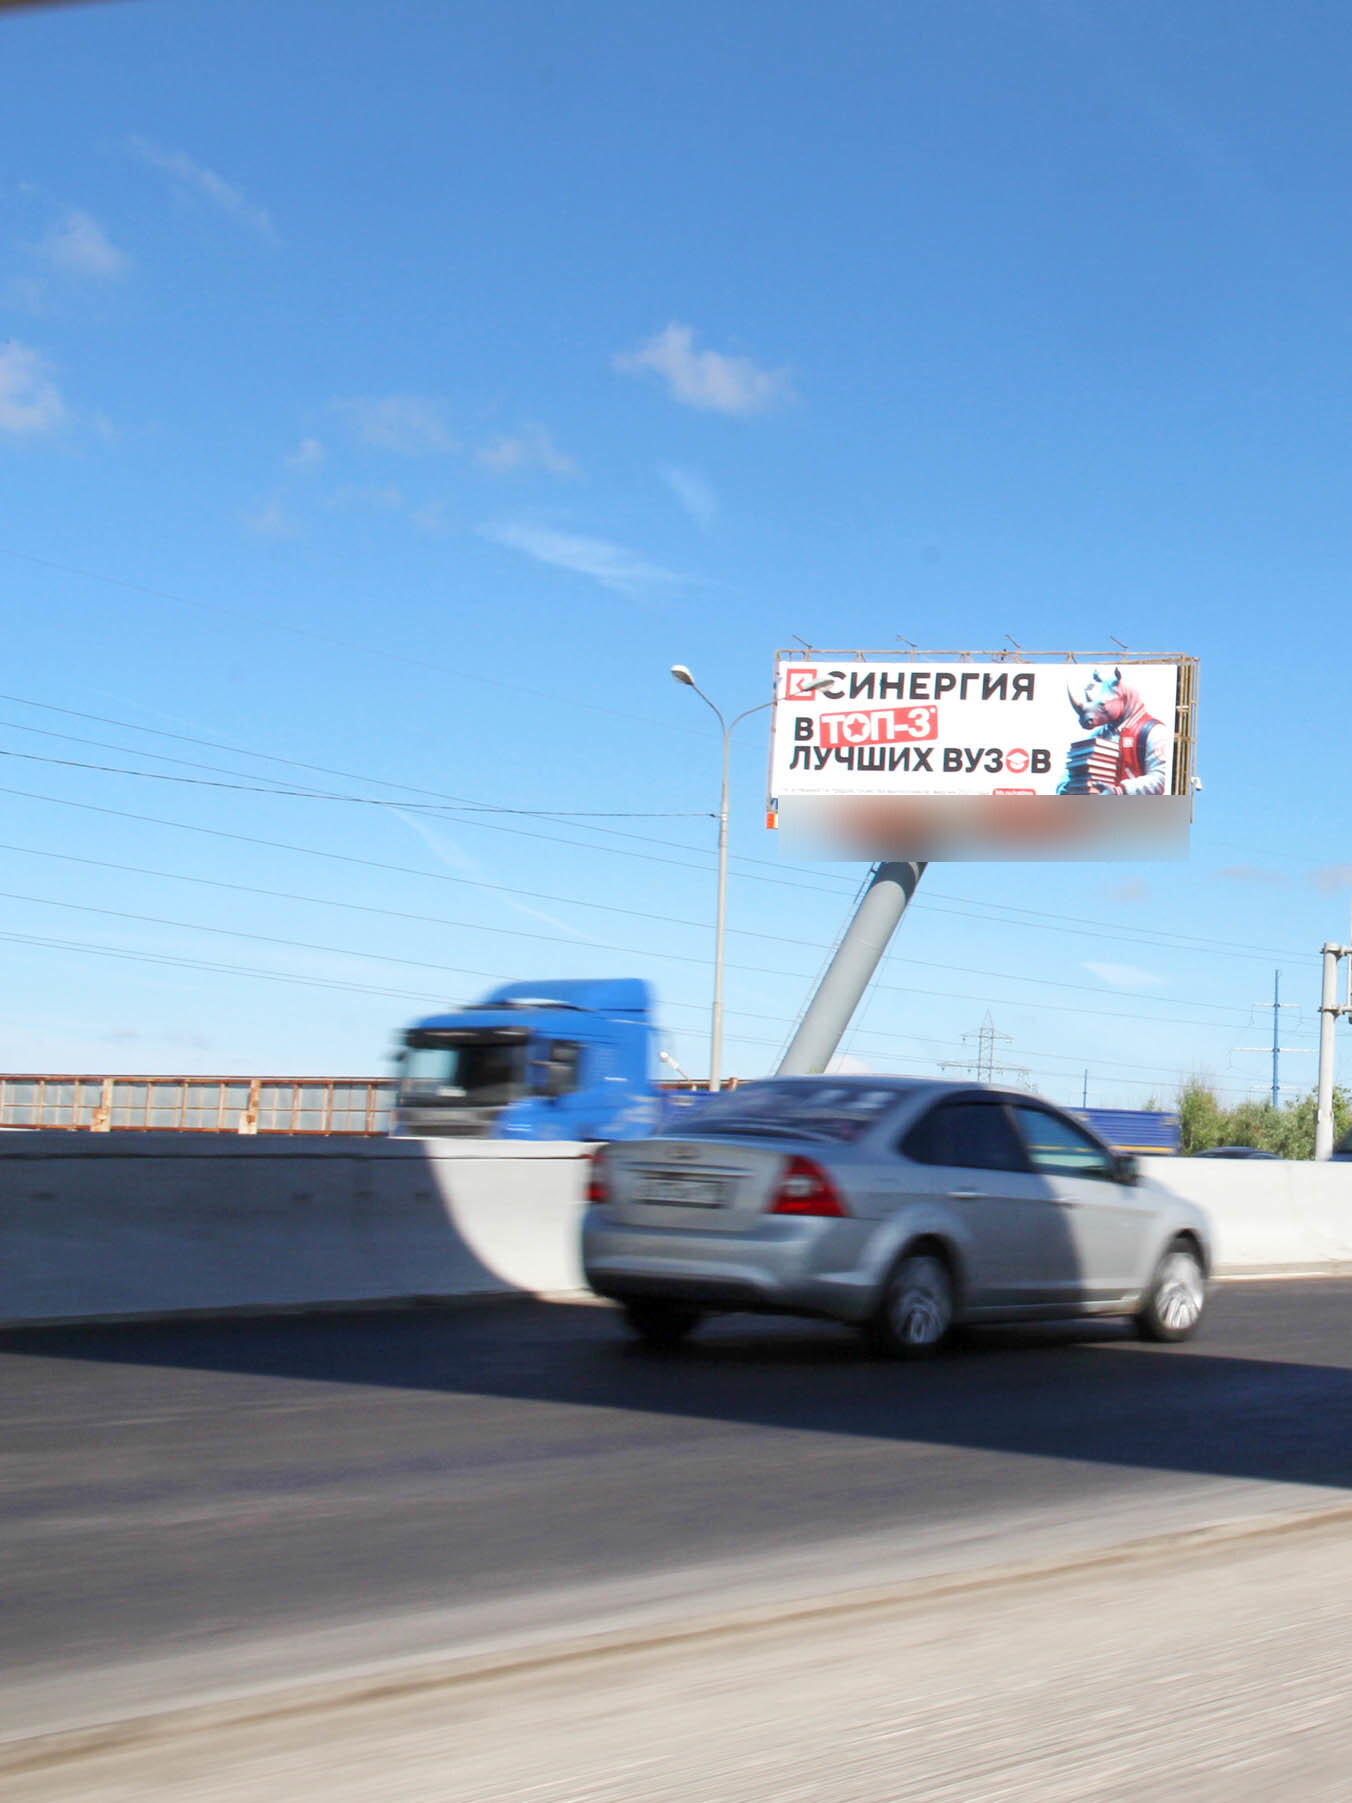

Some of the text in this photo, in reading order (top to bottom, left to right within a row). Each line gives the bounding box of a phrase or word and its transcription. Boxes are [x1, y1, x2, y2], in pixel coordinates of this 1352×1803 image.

[823, 671, 1035, 701] СИНЕРГИЯ
[794, 717, 814, 741] В
[789, 746, 1051, 774] ЛУЧШИХ ВУЗОВ
